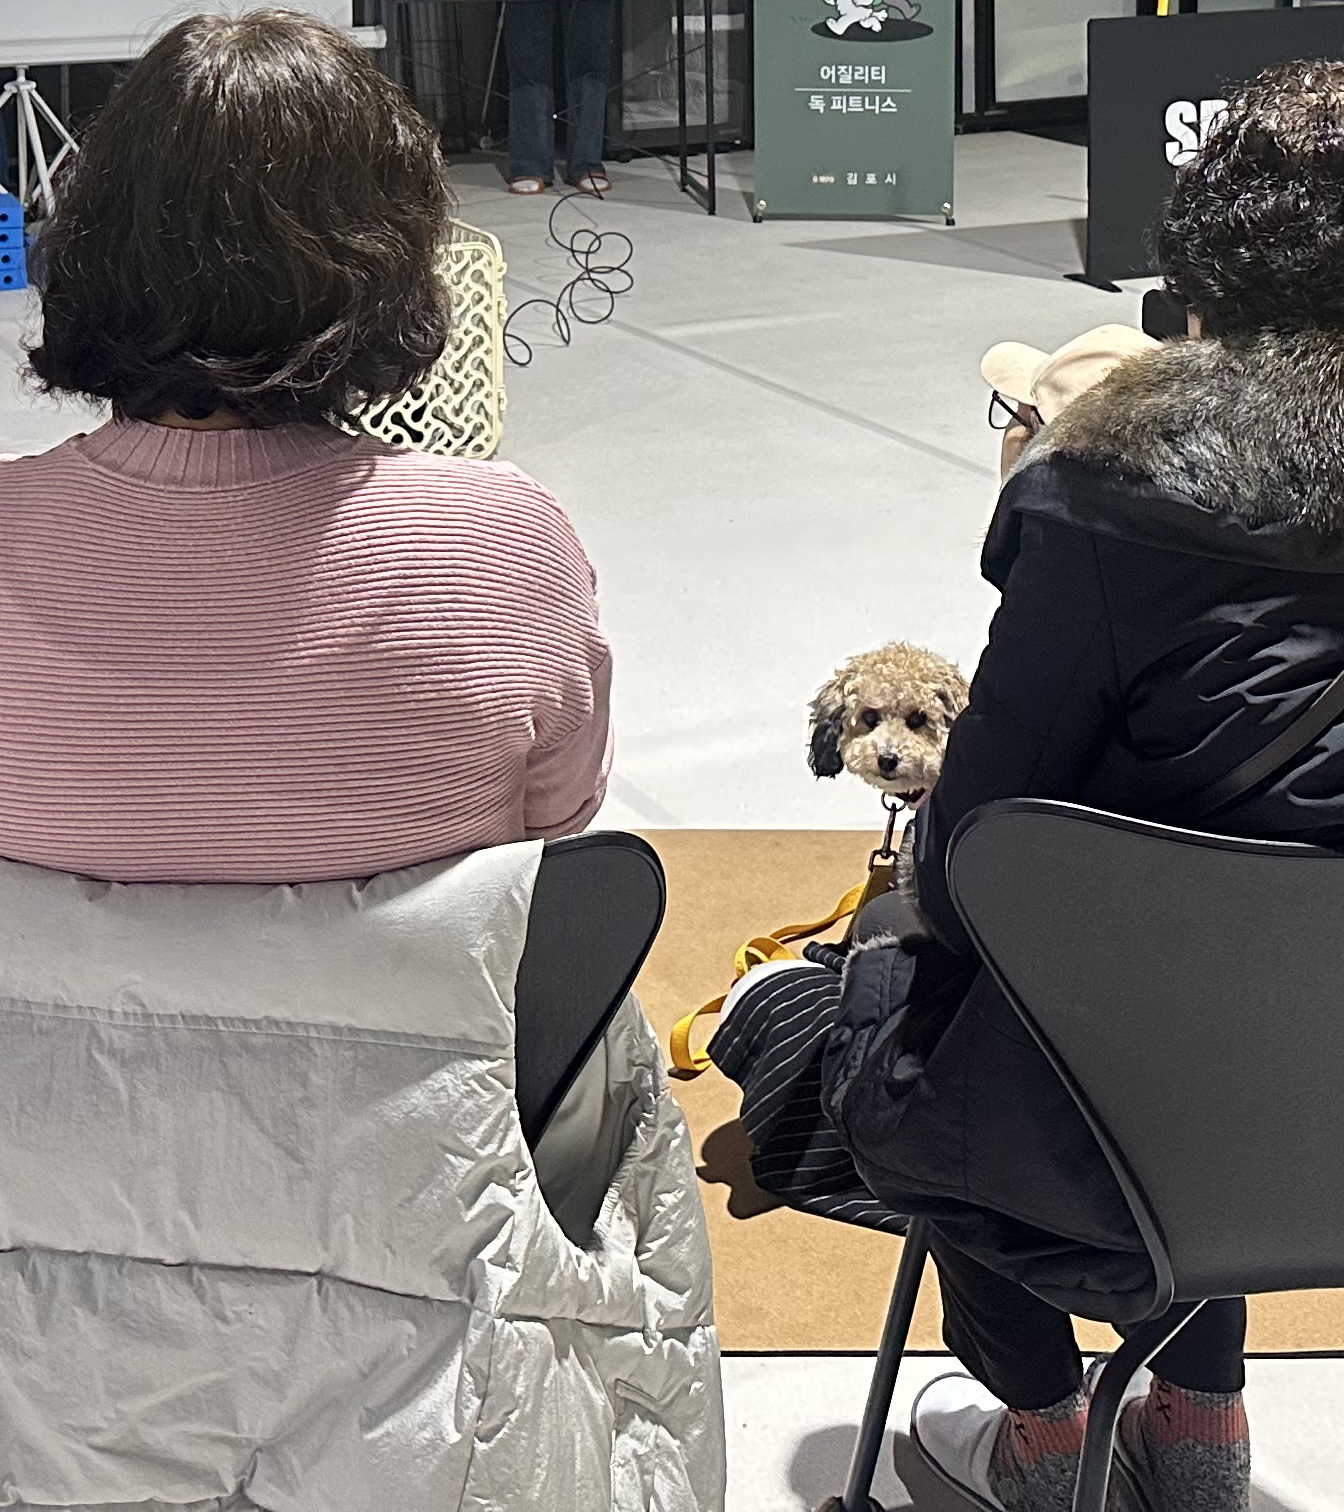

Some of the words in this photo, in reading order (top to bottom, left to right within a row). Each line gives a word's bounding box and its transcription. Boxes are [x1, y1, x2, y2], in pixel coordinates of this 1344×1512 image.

[820, 65, 886, 84] 어질리티
[808, 95, 826, 113] 독
[830, 95, 898, 114] 피트니스
